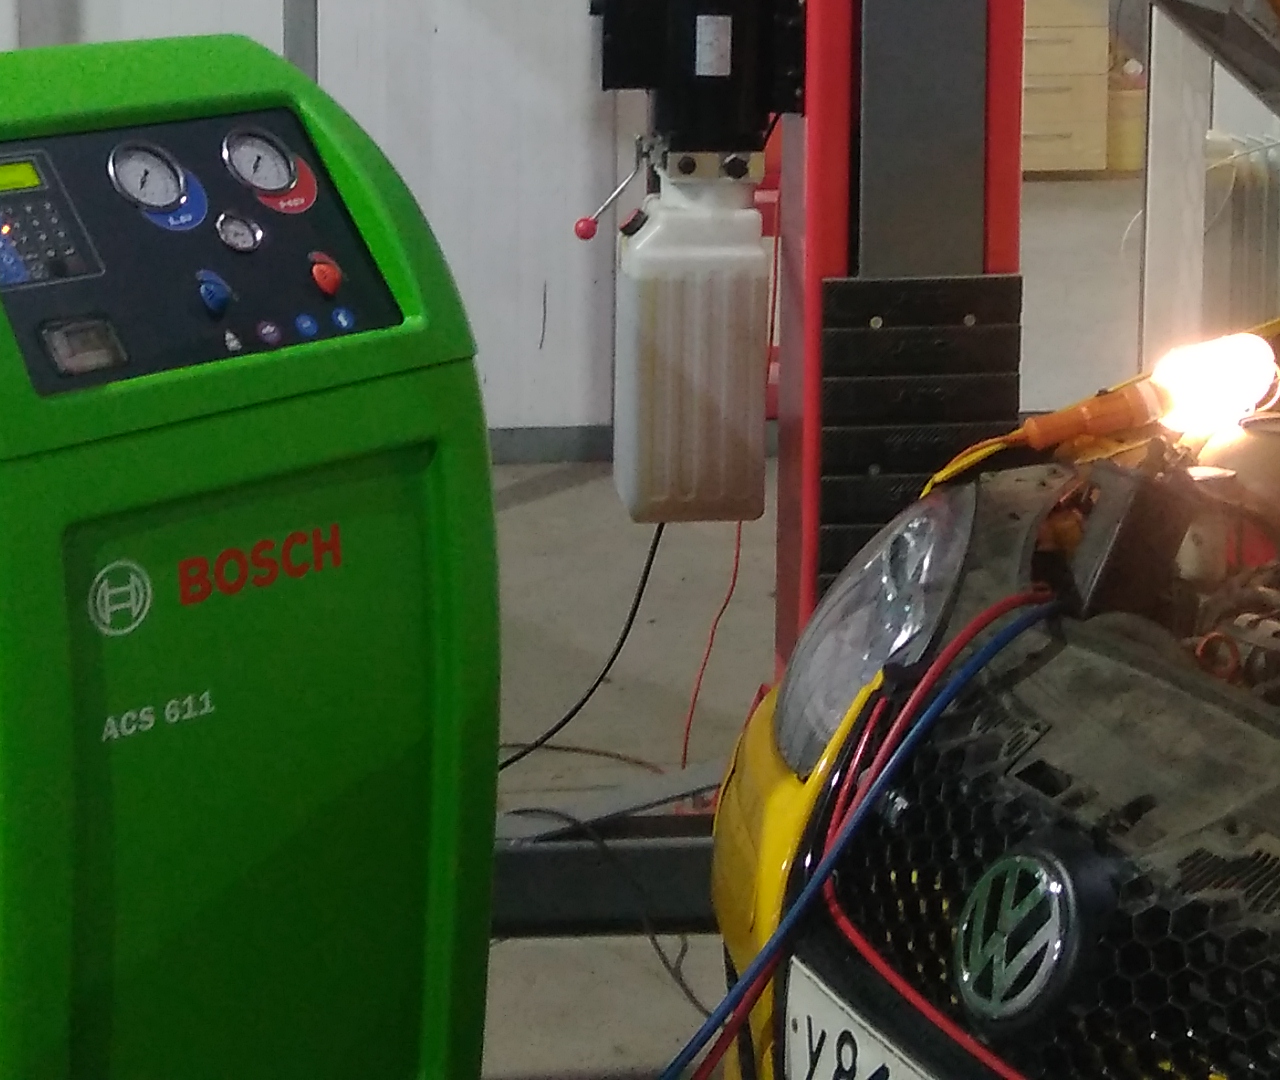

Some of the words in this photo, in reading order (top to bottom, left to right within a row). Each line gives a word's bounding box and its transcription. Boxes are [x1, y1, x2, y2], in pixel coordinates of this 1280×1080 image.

[177, 523, 342, 606] BOSCH
[102, 706, 155, 742] ACS
[164, 690, 215, 723] 611
[806, 1015, 890, 1080] У8
